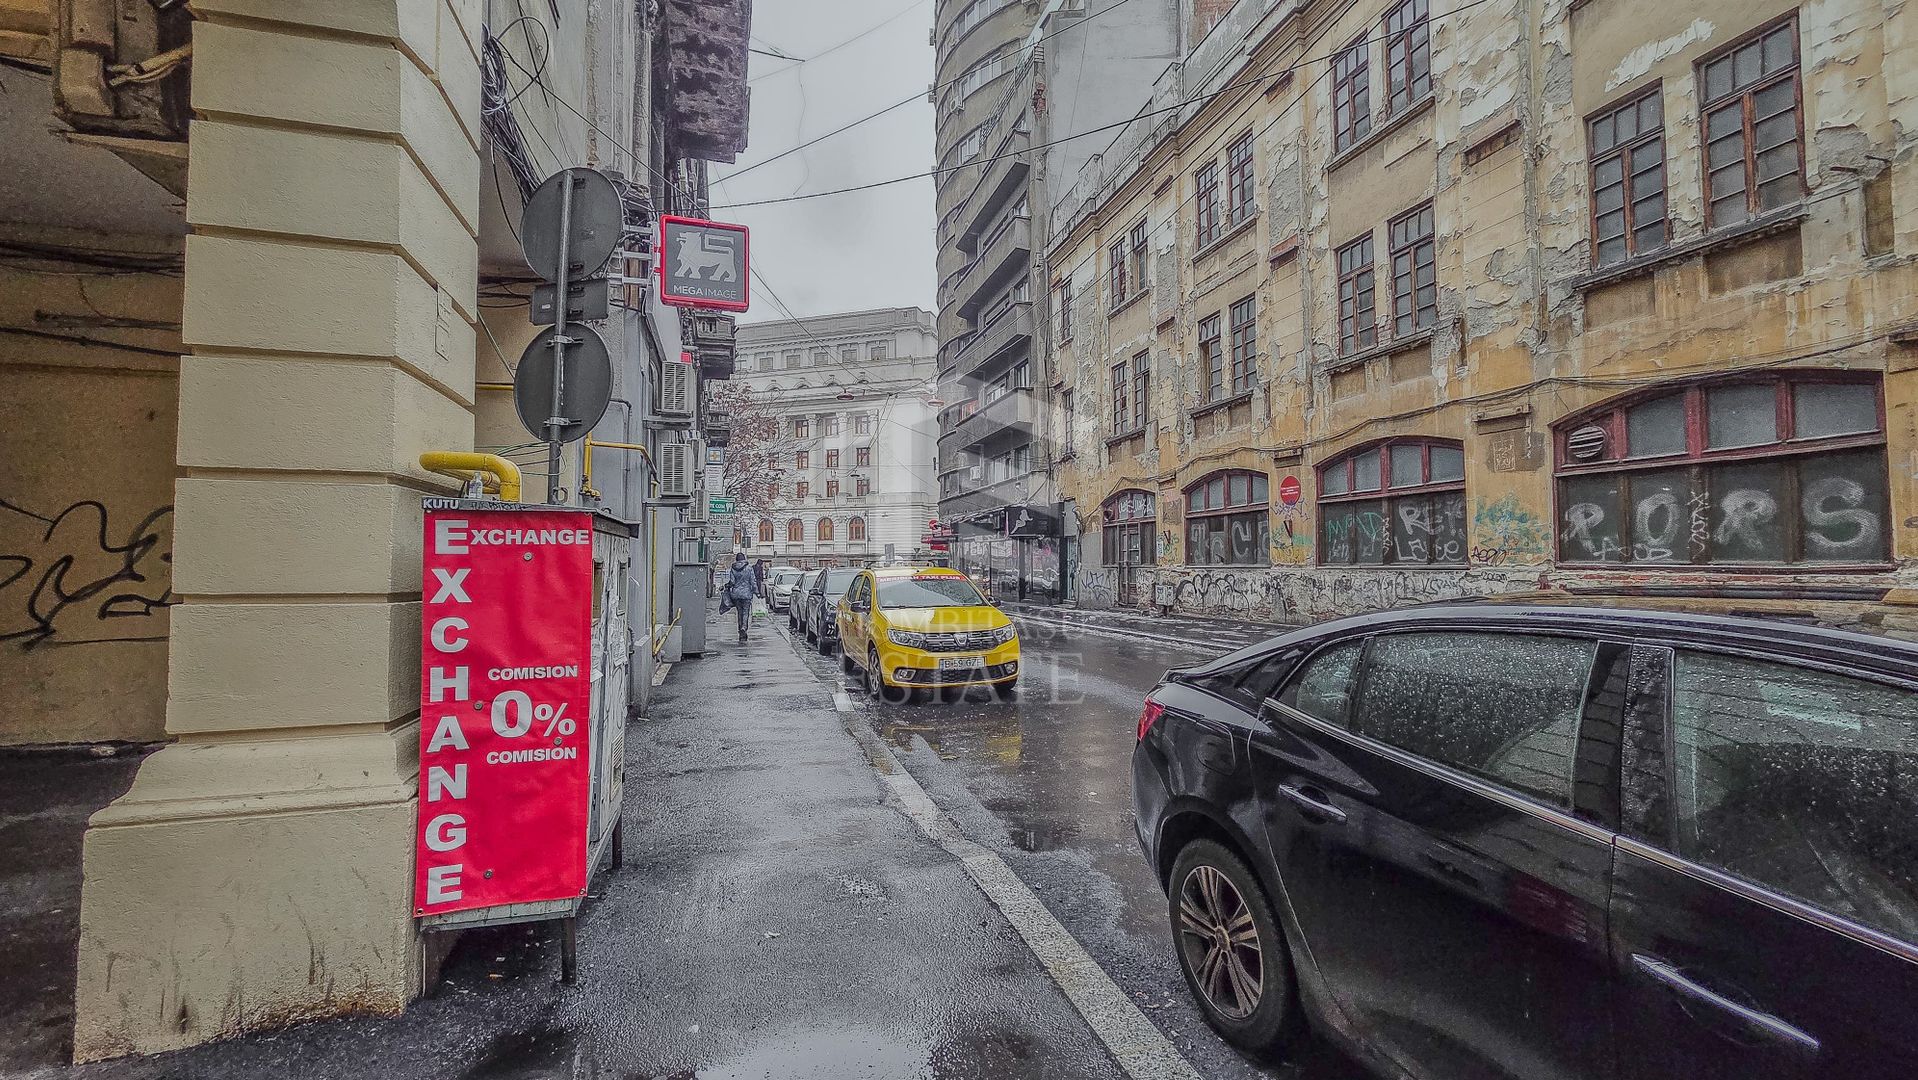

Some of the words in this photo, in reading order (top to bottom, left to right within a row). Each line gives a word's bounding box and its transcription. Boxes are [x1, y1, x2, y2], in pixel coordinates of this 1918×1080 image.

[673, 285, 704, 295] MEGA
[705, 288, 737, 299] IMAGE
[423, 499, 459, 509] KUTU
[487, 665, 578, 681] COMISION
[490, 690, 577, 738] 0%
[486, 746, 577, 765] COMISION
